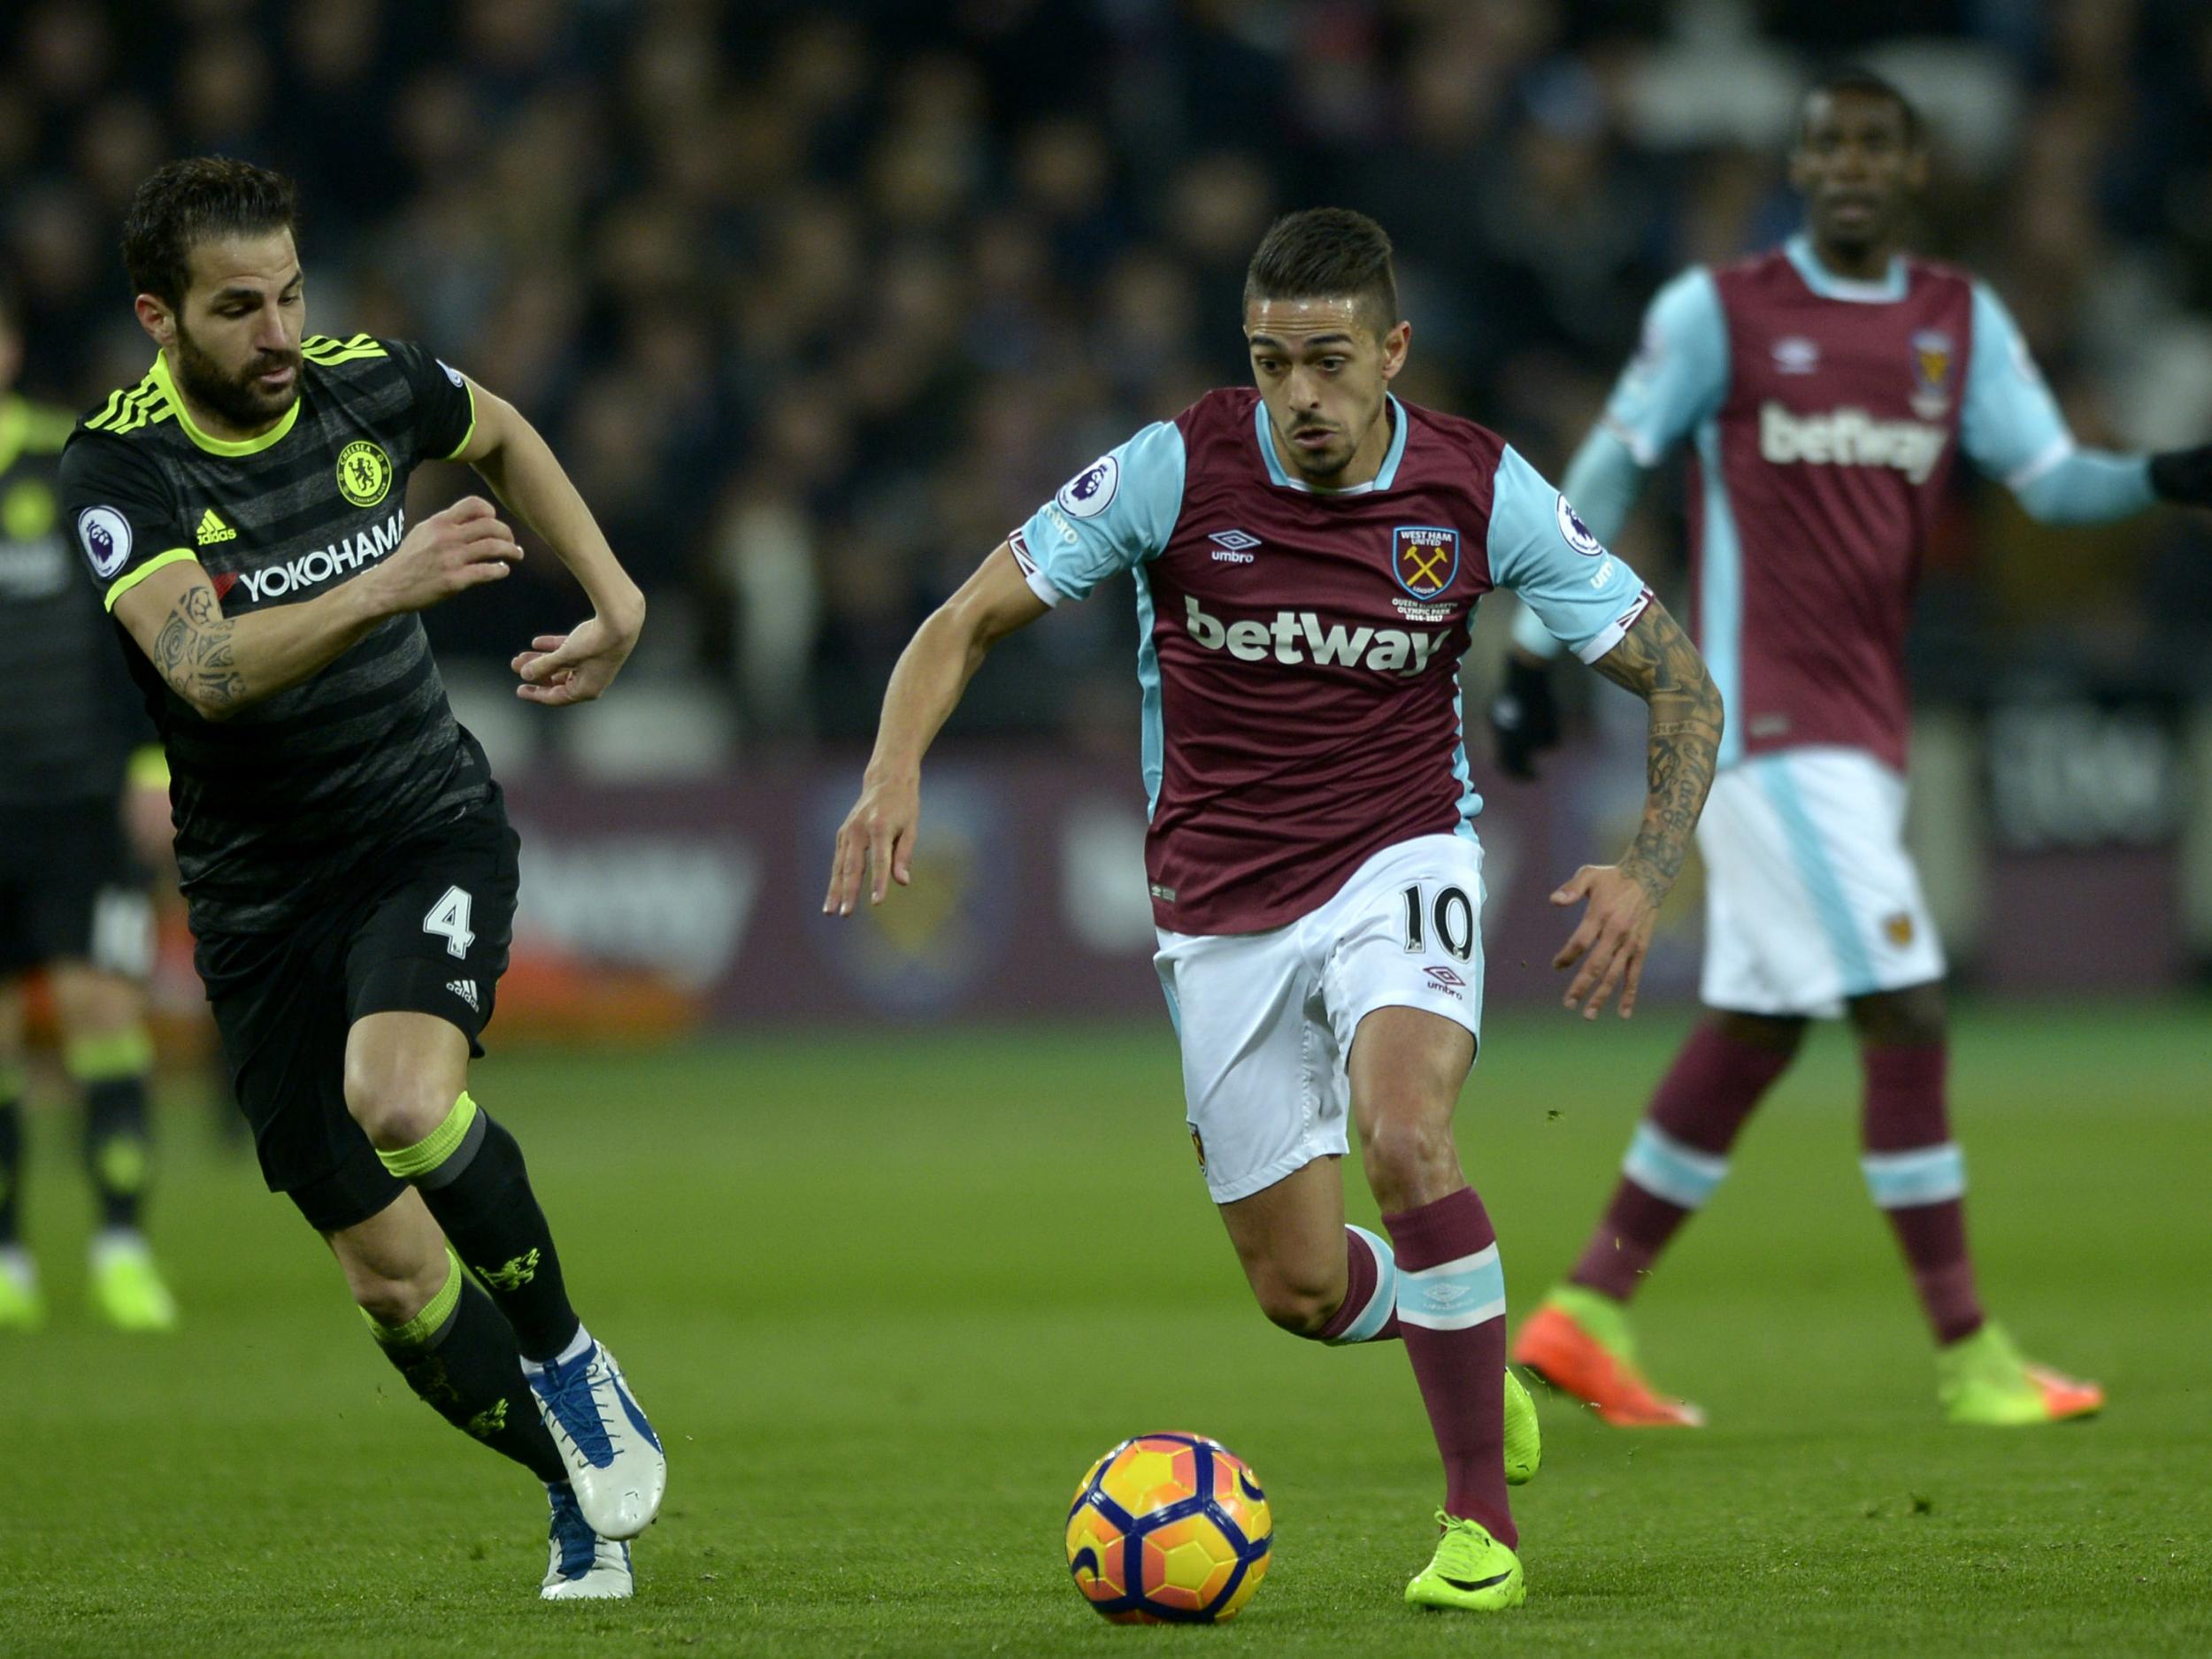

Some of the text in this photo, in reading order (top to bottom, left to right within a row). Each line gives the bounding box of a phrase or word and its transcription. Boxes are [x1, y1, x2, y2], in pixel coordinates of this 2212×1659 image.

[341, 444, 371, 465] CHELSEA
[1401, 531, 1452, 541] WEST HAM
[1211, 550, 1255, 564] umbro
[1392, 598, 1418, 608] QUEEN
[424, 885, 475, 960] 4
[1400, 883, 1473, 964] 10
[446, 982, 480, 1013] adidas
[1427, 981, 1463, 1000] umbro
